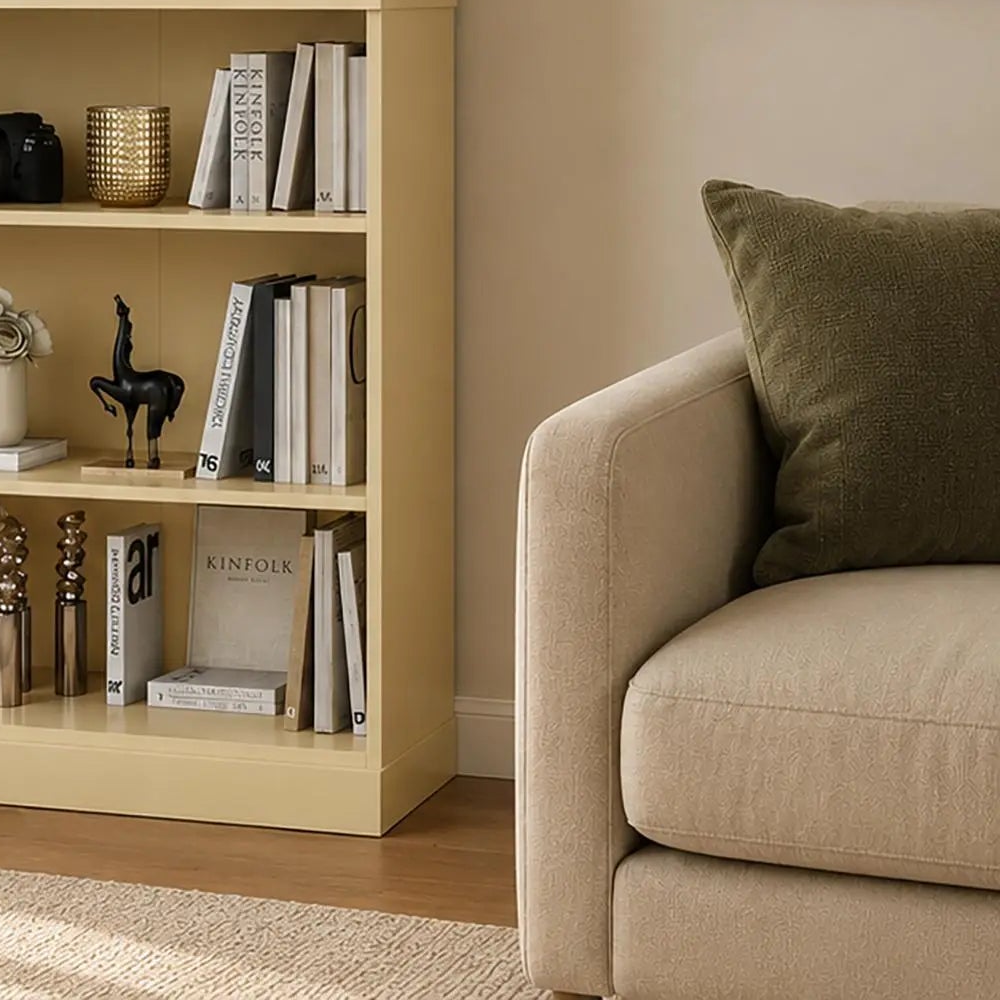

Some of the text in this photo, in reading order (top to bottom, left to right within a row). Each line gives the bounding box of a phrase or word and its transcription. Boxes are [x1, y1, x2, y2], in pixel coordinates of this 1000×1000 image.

[233, 69, 248, 161] KINFOLK
[250, 69, 263, 161] KINFOLK
[127, 531, 159, 605] ar
[207, 556, 293, 574] KINFOLK
